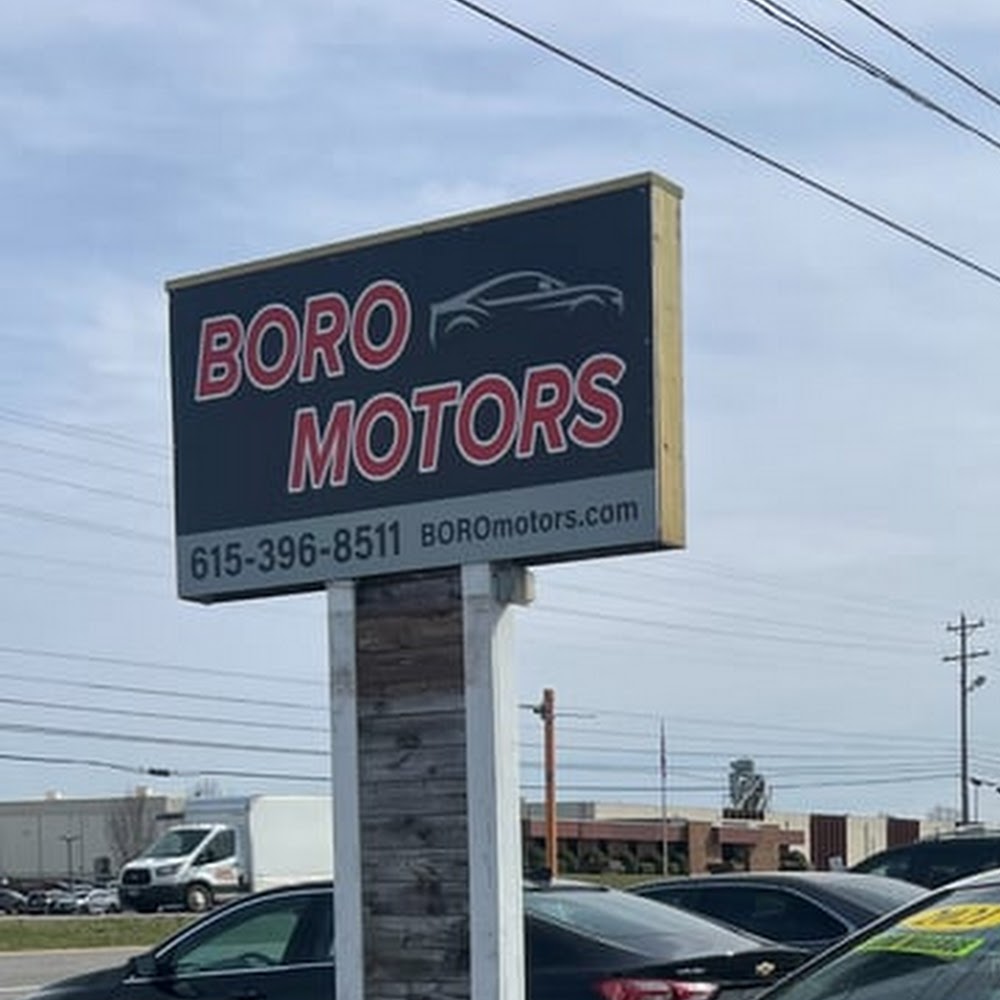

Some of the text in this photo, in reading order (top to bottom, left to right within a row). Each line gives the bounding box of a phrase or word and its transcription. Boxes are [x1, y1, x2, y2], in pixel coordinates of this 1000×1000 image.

[195, 279, 411, 402] BORO
[288, 353, 626, 493] MOTORS
[190, 499, 639, 581] 615-396-8511 BOROmotors.com
